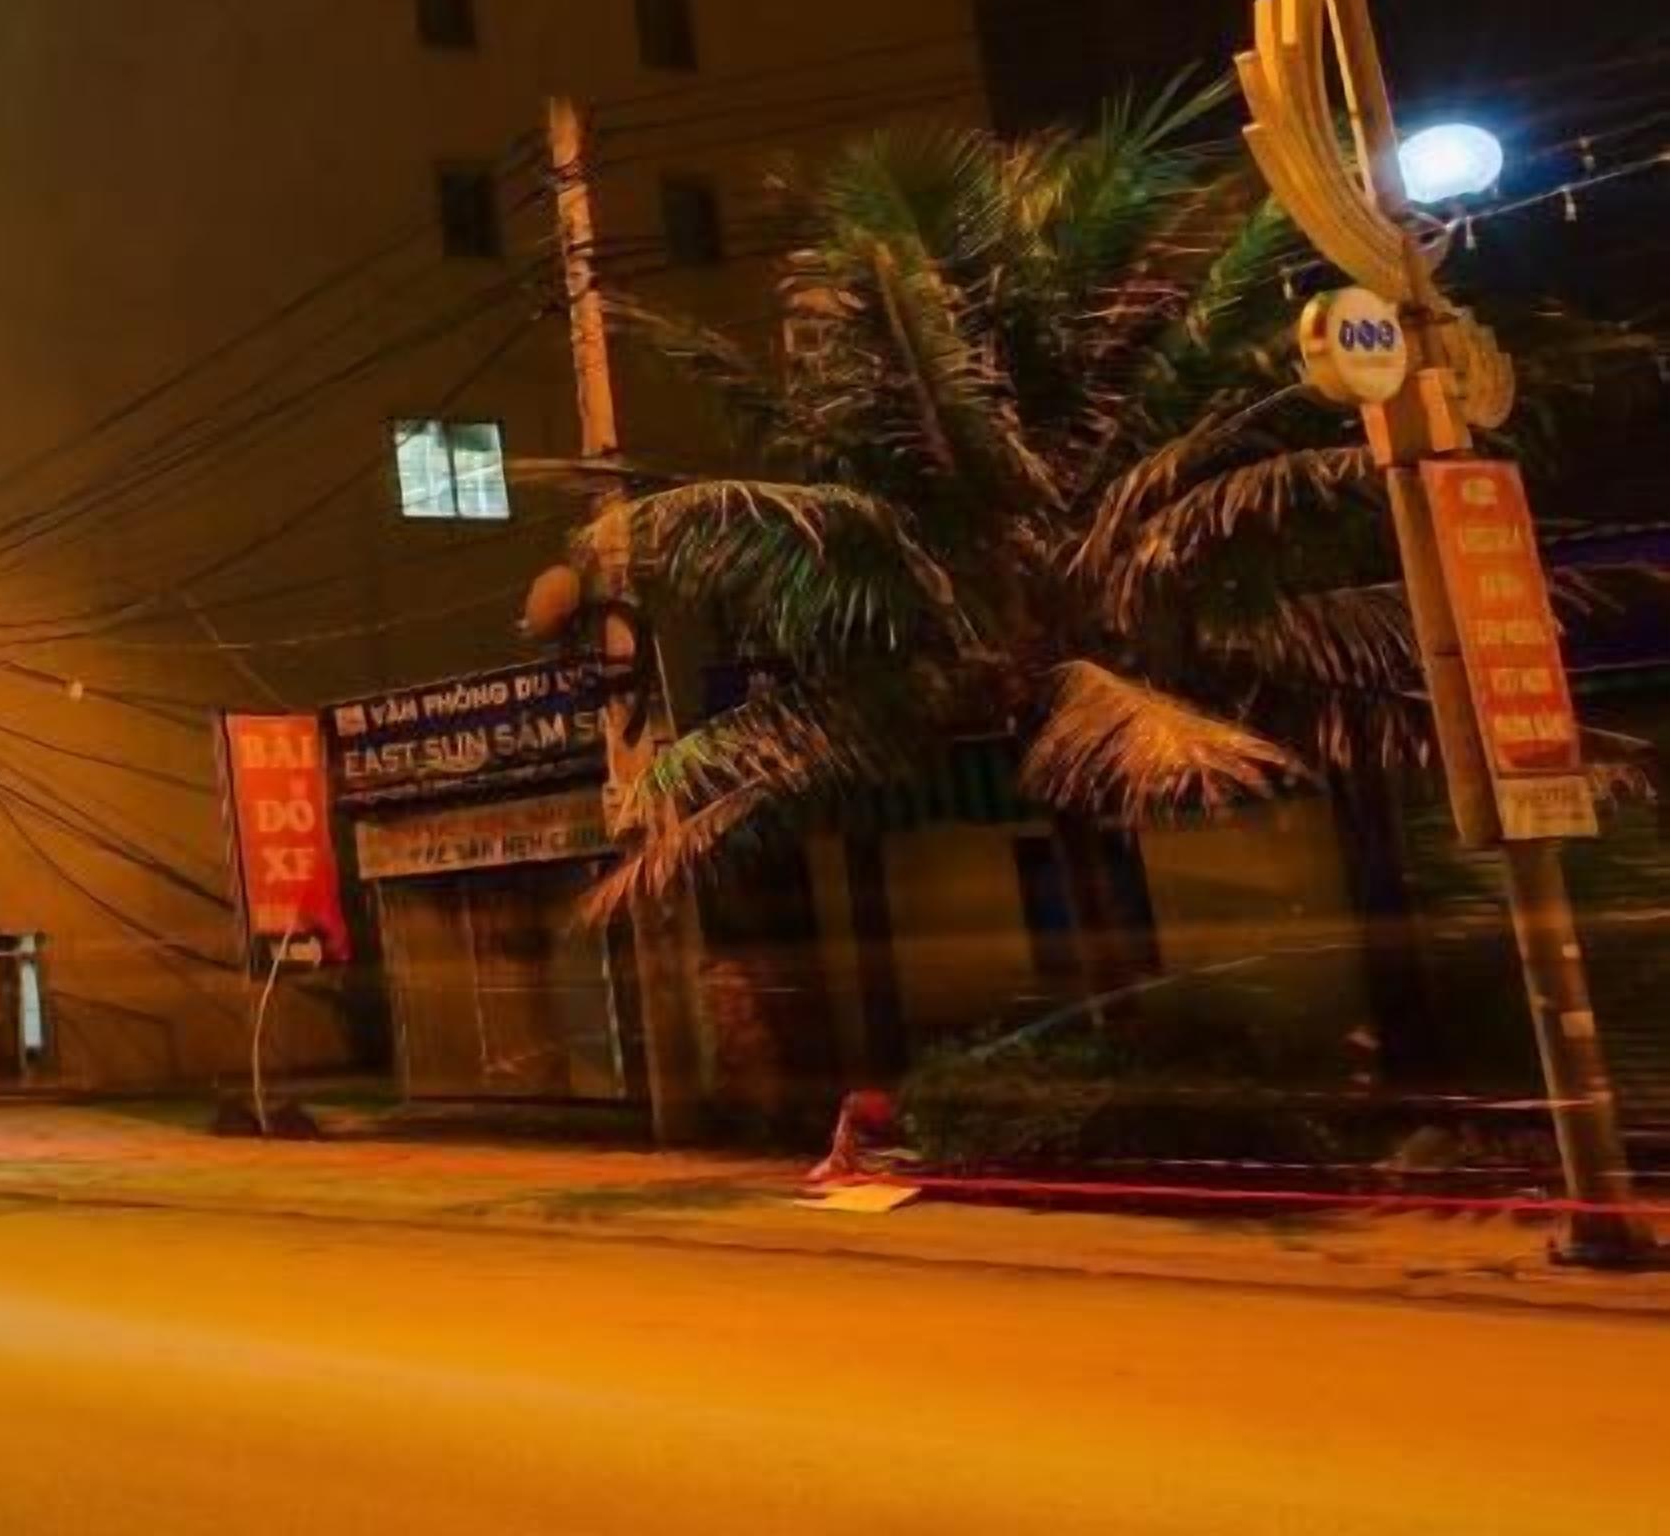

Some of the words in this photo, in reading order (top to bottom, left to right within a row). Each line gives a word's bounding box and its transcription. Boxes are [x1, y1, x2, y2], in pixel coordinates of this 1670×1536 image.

[344, 741, 416, 779] EAST
[425, 725, 489, 765] SUN
[262, 848, 316, 883] XE
